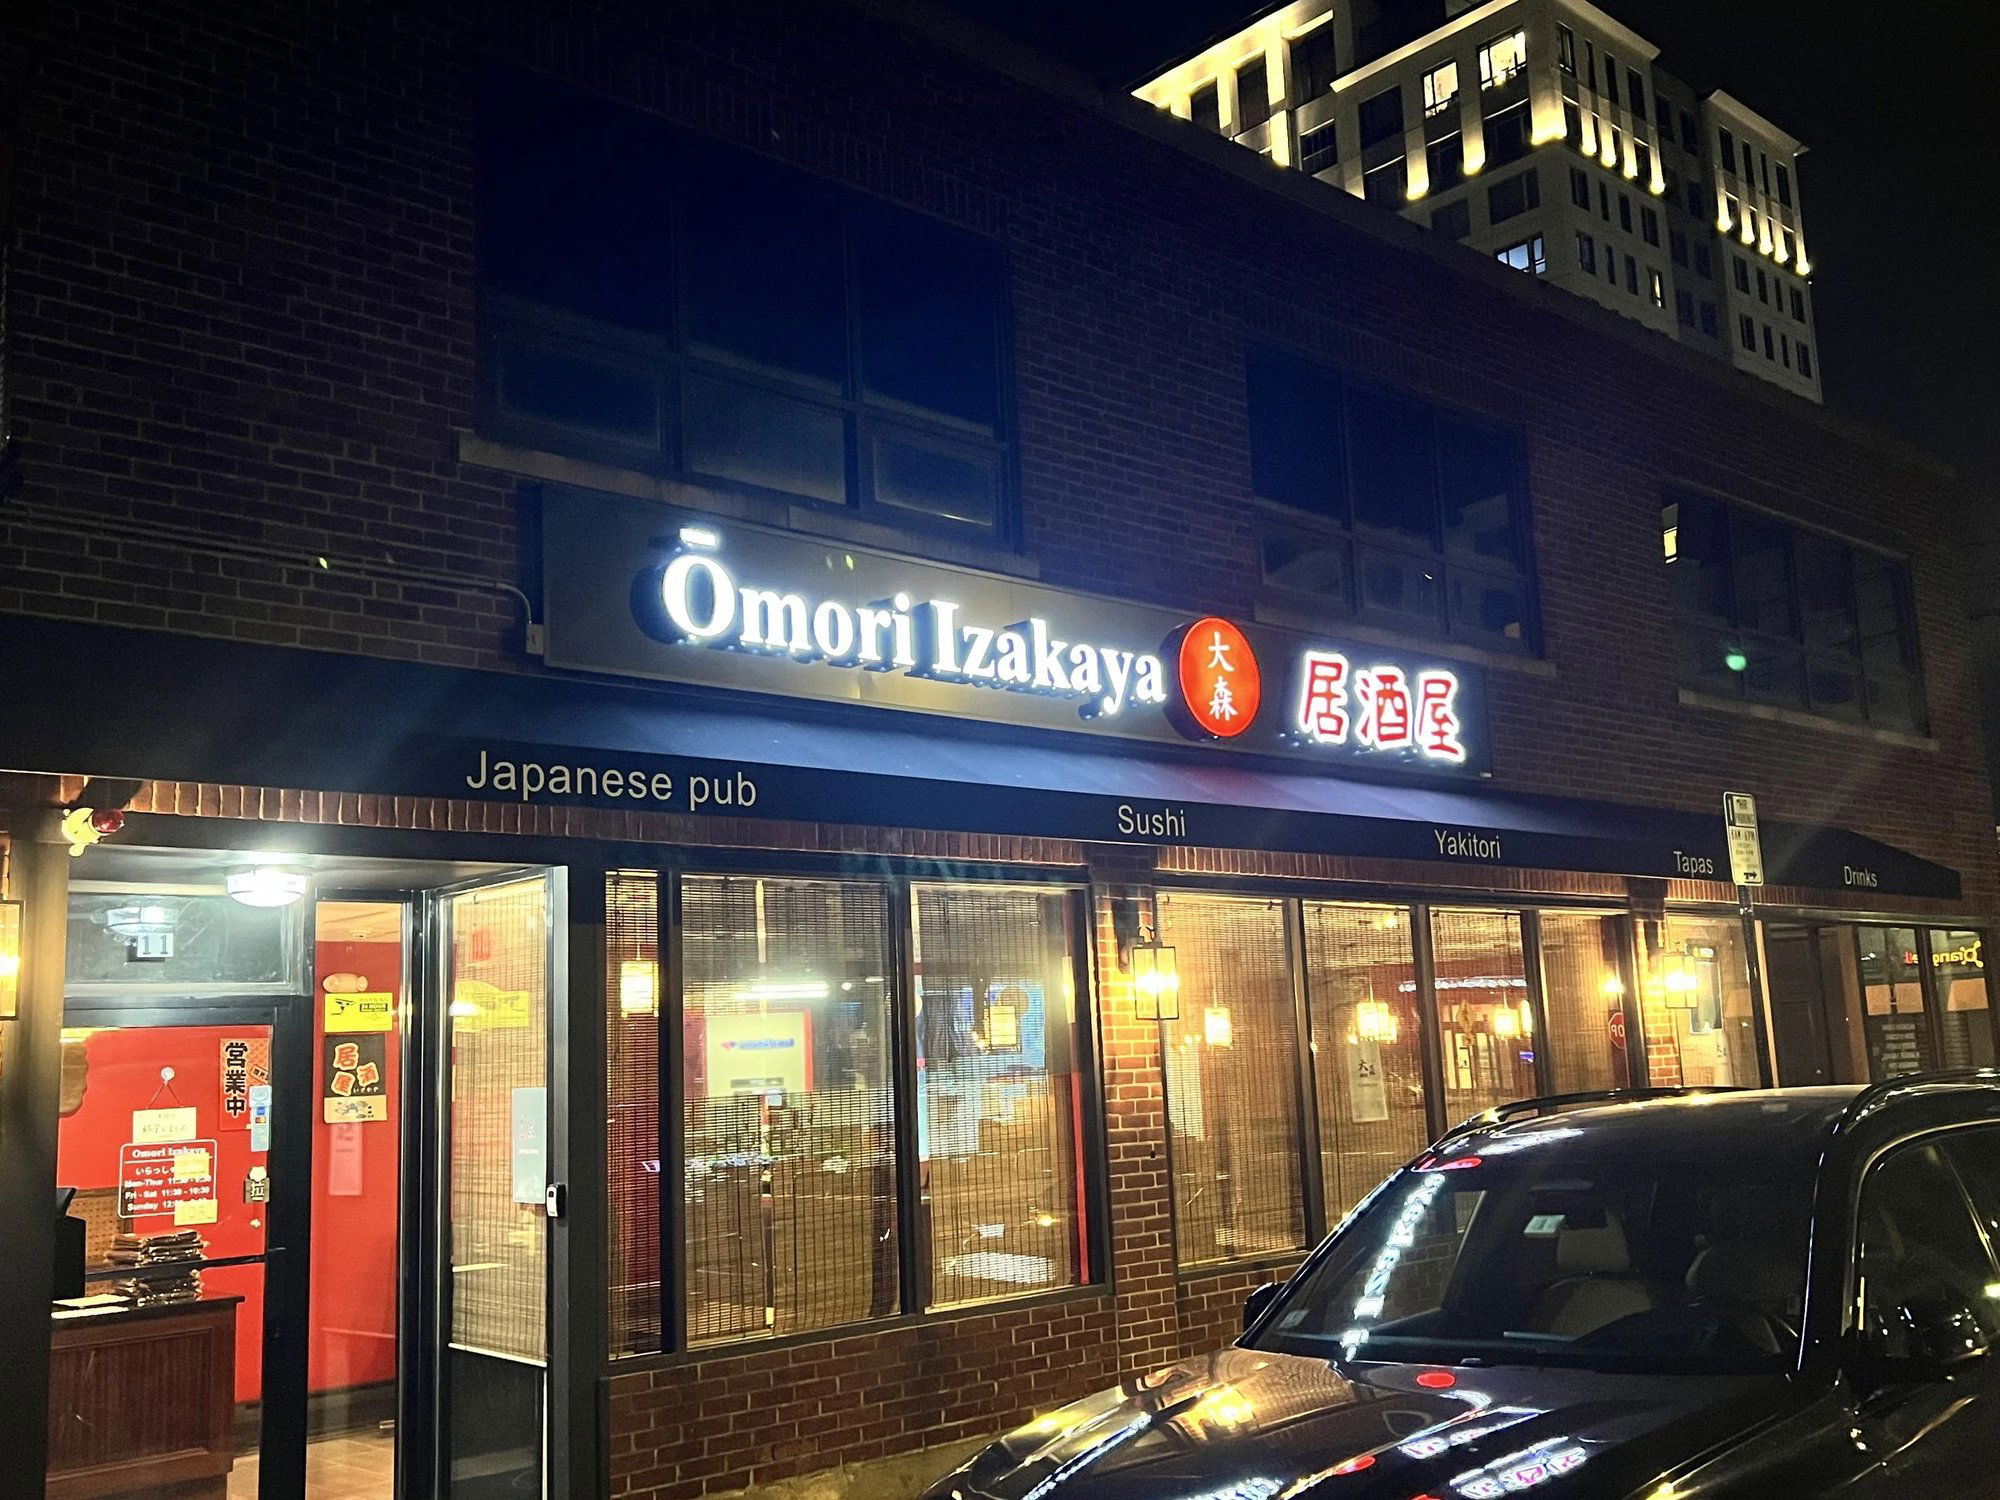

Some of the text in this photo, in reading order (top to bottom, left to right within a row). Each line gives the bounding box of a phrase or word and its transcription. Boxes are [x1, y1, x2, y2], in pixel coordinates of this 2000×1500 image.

[661, 527, 1167, 715] Ōmori Izakaya
[1207, 631, 1237, 721] 大森
[1298, 650, 1466, 763] 居酒屋
[466, 750, 757, 812] Japanese pub
[1117, 804, 1187, 838] Sushi
[1434, 828, 1501, 860] Yakitori
[1673, 850, 1714, 877] Tapas
[1844, 866, 1878, 888] Drinks
[142, 934, 169, 955] 11
[225, 1041, 248, 1117] 営業中
[132, 1147, 166, 1158] Omori
[127, 1203, 158, 1212] Sunday
